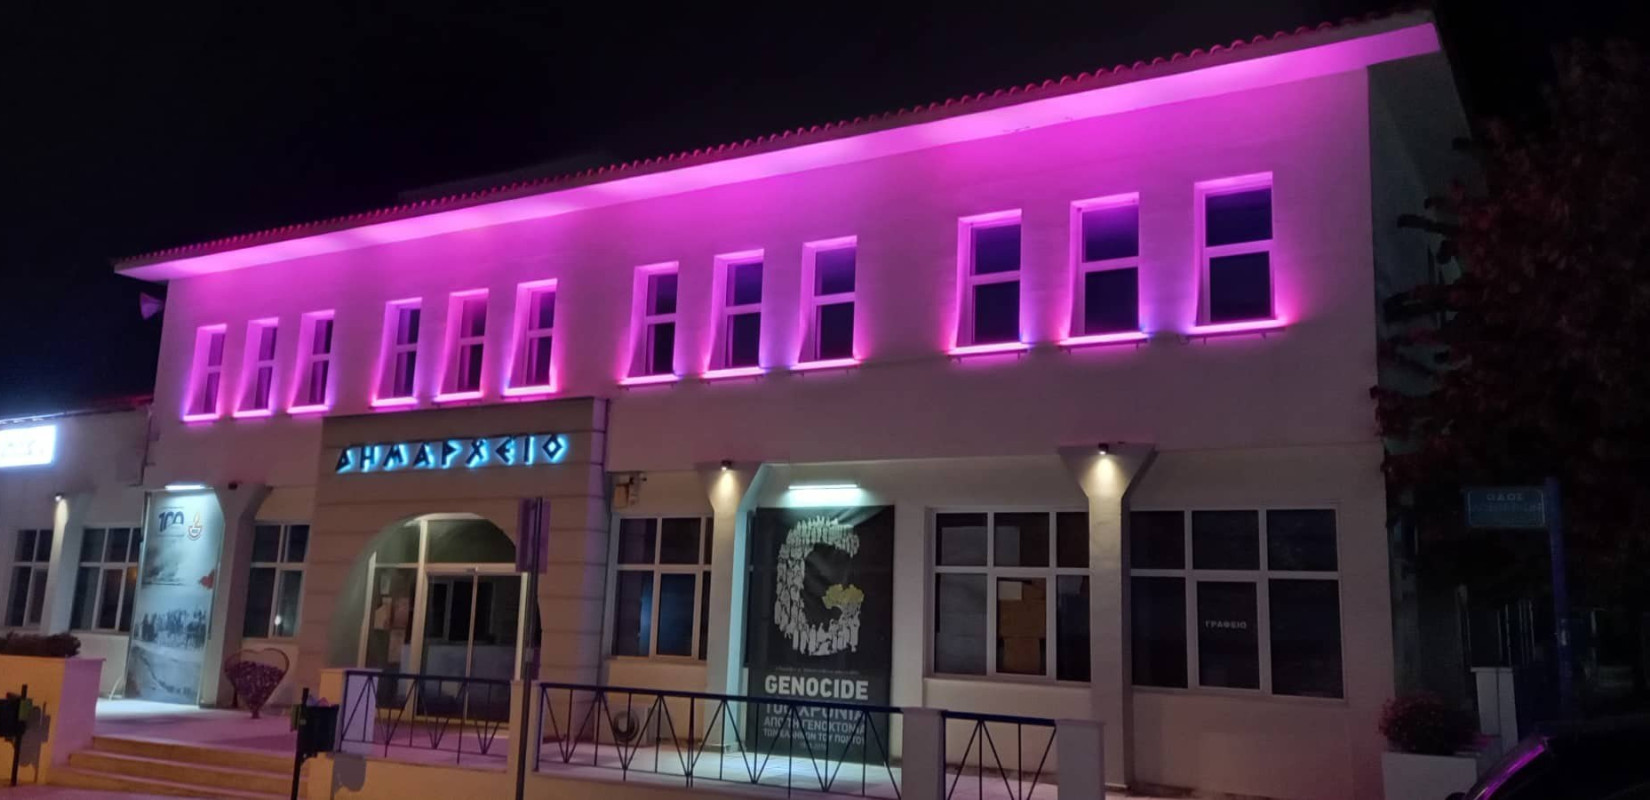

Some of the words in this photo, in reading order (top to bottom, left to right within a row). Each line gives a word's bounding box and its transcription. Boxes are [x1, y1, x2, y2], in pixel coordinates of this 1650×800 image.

[335, 434, 566, 472] ΔΗΜΑΡΧΕΙΟ
[1205, 620, 1247, 629] ΓΡΑΦΕΙΟ
[764, 675, 869, 700] GENOCIDE
